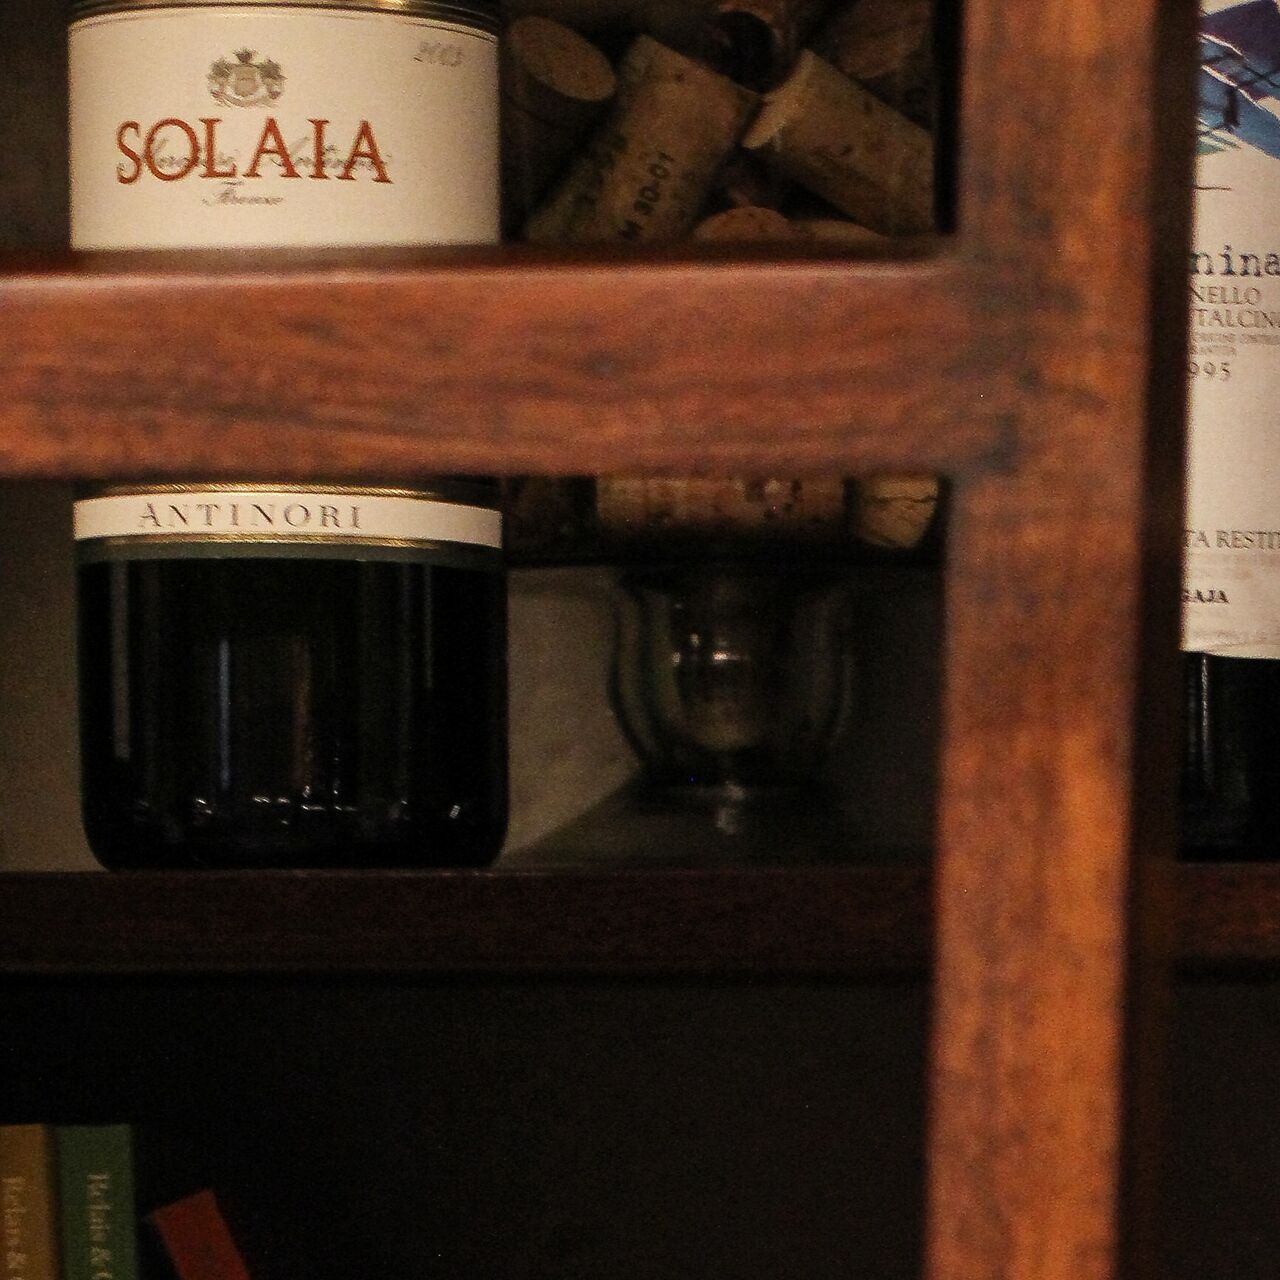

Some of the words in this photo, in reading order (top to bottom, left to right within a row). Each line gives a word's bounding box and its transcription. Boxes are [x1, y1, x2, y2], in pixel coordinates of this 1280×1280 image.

[117, 117, 393, 185] SOLAIA
[1190, 286, 1261, 305] NELLO
[1190, 361, 1232, 381] 995
[139, 500, 364, 532] ANTINORI
